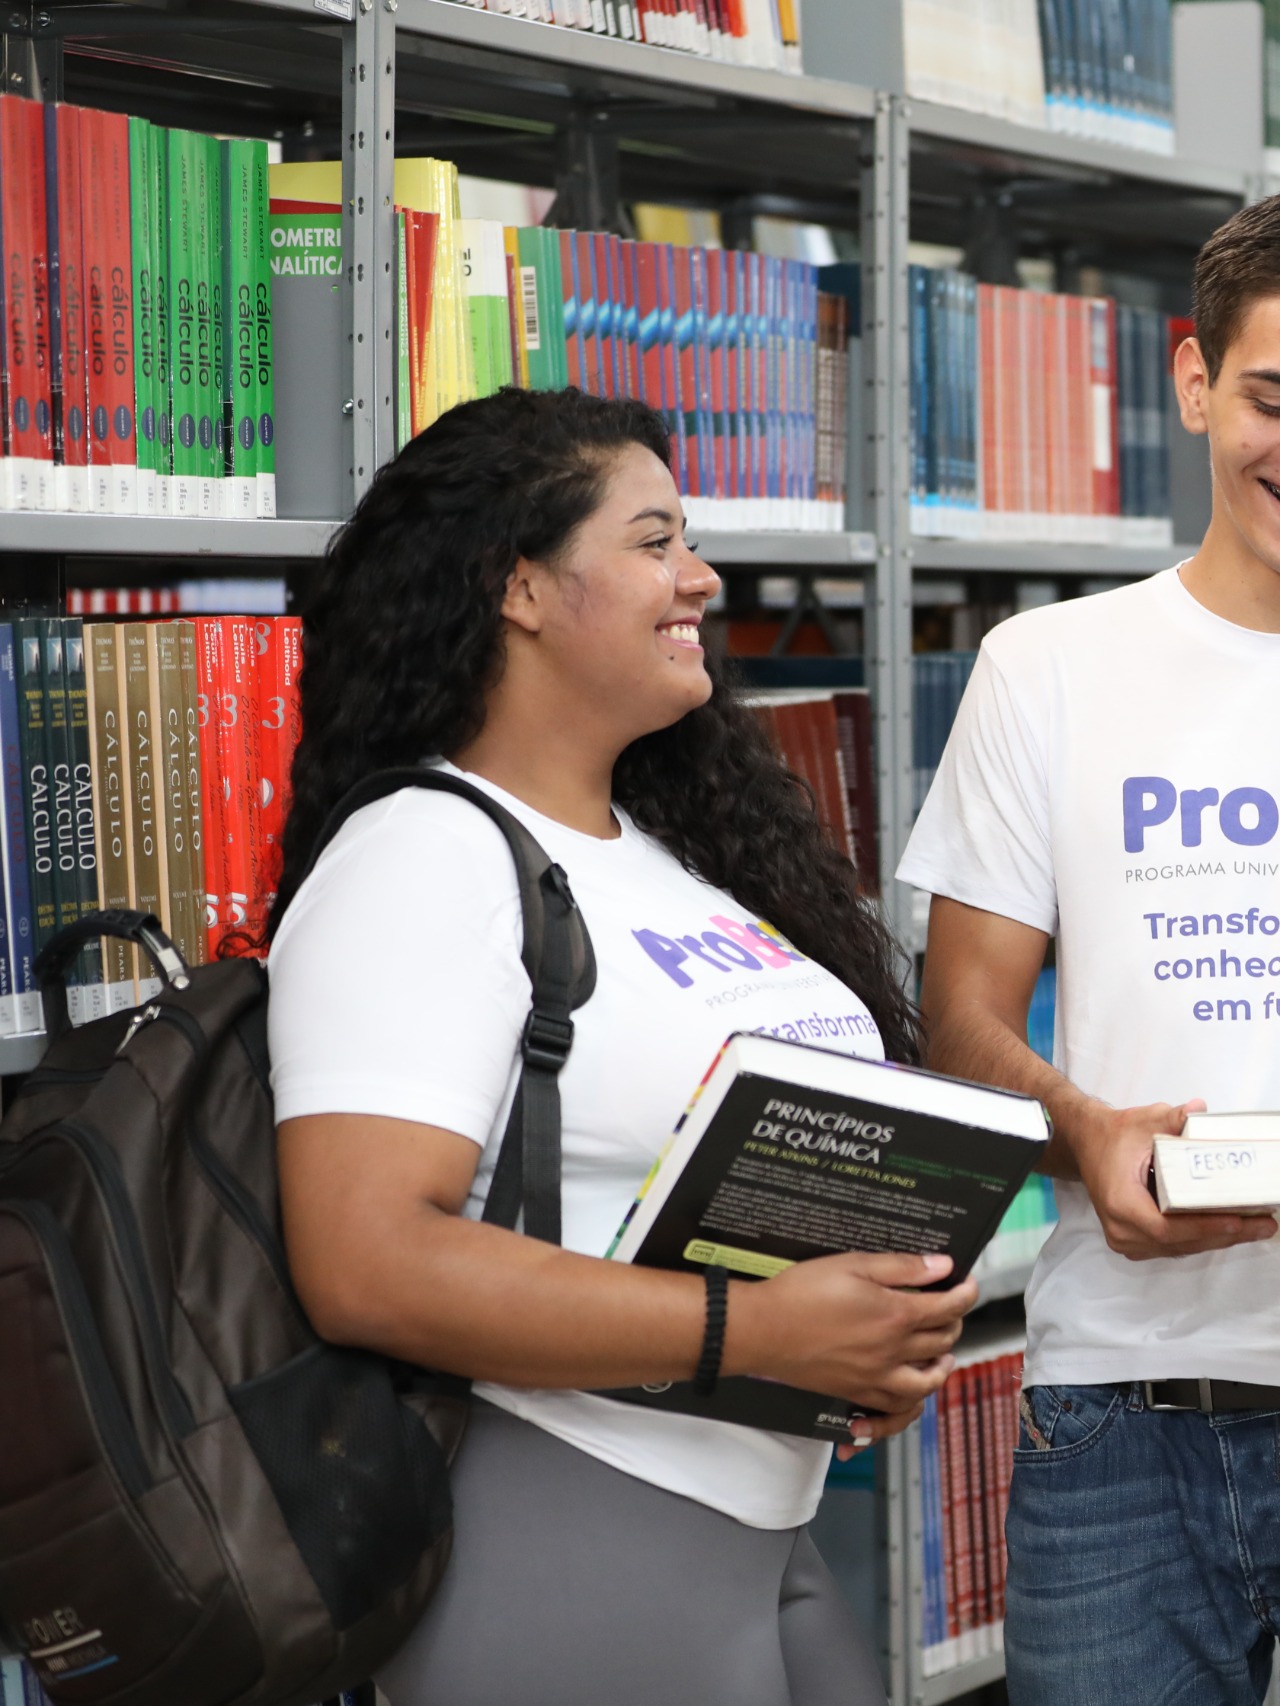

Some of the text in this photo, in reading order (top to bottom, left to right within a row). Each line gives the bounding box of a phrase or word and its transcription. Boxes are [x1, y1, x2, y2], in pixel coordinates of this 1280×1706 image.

[180, 154, 189, 253] JAMES STEWART
[258, 206, 266, 260] STEWART
[90, 265, 106, 376] cálculo
[111, 266, 129, 377] cálculo
[140, 268, 154, 378] cálculo
[156, 276, 167, 384] cálculo
[178, 278, 194, 386] cálculo
[197, 281, 212, 388] cálculo
[213, 285, 224, 390] cálculo
[238, 284, 255, 389] cálculo
[256, 282, 272, 387] cálculo
[204, 623, 213, 683] Leithold
[232, 624, 241, 684] Leithold
[262, 696, 285, 729] 3
[104, 709, 122, 858] CÁLCULO
[137, 709, 153, 856] CÁLCULO
[168, 707, 184, 853] CÁLCULO
[186, 707, 201, 850] CÁLCULO
[240, 695, 250, 709] O
[245, 785, 260, 848] Geometria
[266, 834, 274, 844] 5
[1125, 861, 1226, 883] PROGRAMA
[1193, 998, 1252, 1022] em
[743, 1139, 779, 1158] PETER
[830, 1160, 882, 1182] LORETTA
[879, 1170, 917, 1189] JONES
[752, 1119, 880, 1165] DE QUÍMICA
[763, 1098, 896, 1144] PRINCÍPIOS
[1193, 1151, 1253, 1171] FESGO
[817, 1412, 847, 1425] grupo
